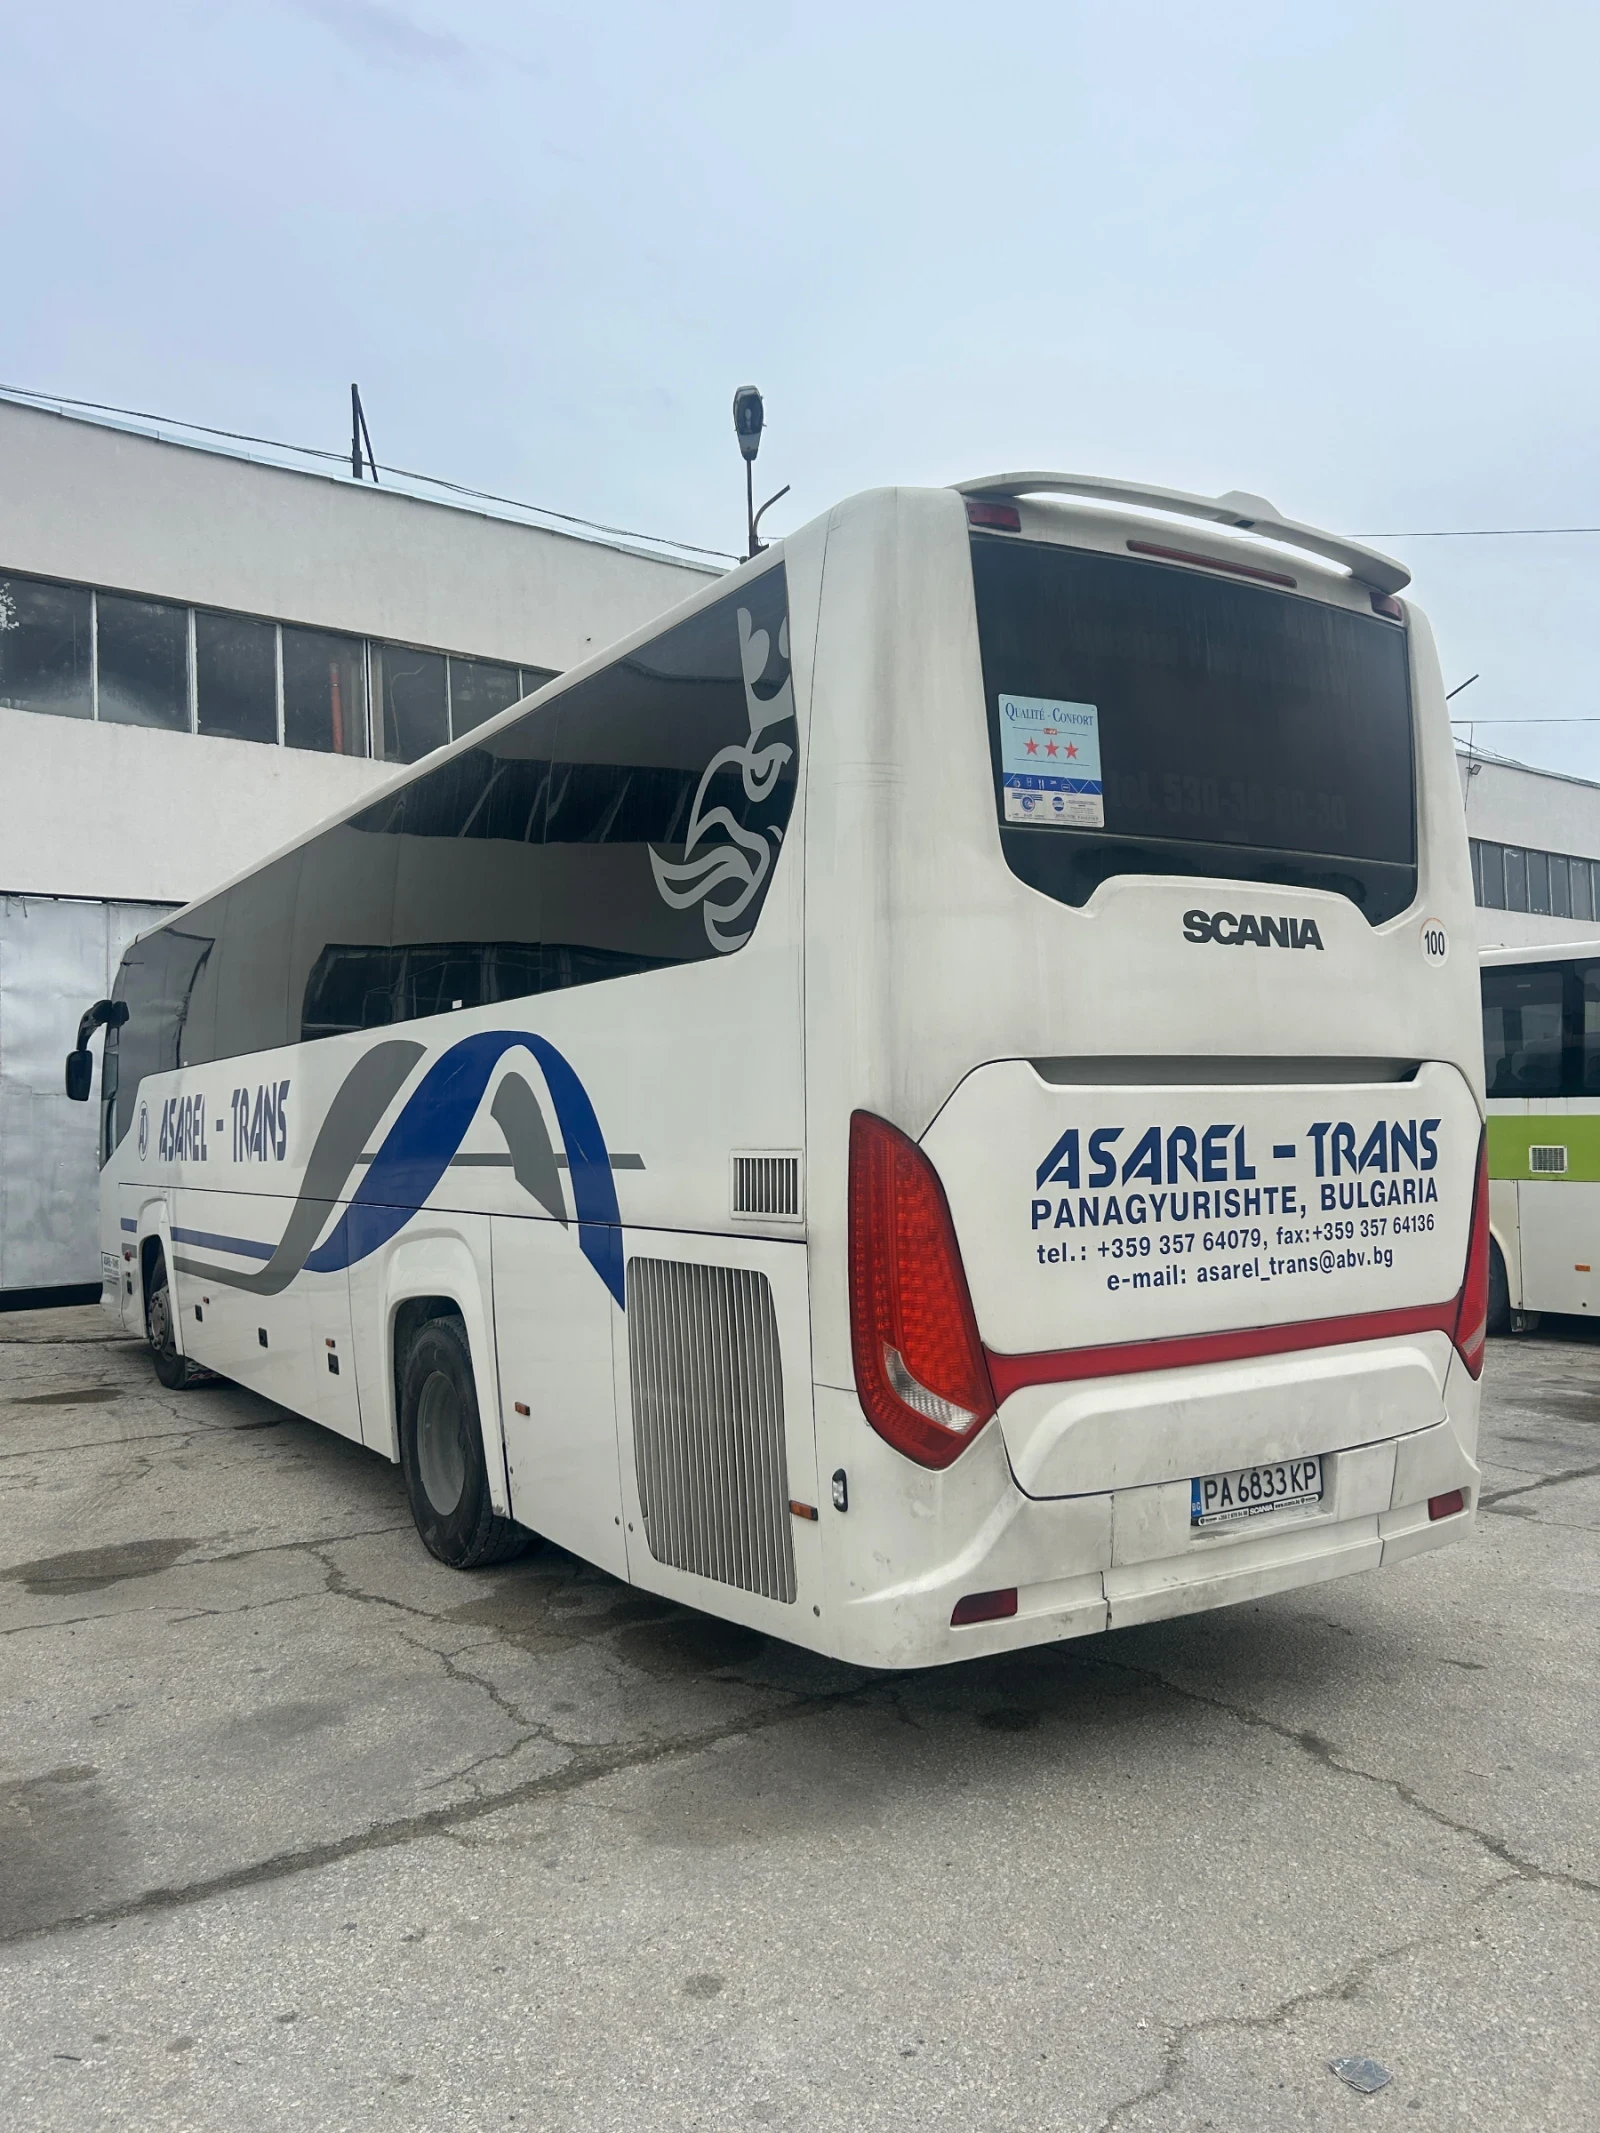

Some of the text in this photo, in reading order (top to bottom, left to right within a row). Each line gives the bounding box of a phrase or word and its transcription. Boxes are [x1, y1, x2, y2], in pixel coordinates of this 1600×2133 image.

[1005, 702, 1045, 721] QUALITÉ
[1052, 707, 1094, 726] CONFORT
[1182, 909, 1325, 950] SCANIA
[1424, 930, 1445, 956] 100
[158, 1093, 207, 1162] ASAREL
[230, 1079, 291, 1163] TRANS
[1036, 1124, 1257, 1192] ASAREL
[1305, 1118, 1442, 1178] TRANS
[1031, 1177, 1439, 1230] PANAGYURISHTE, BULGARIA
[1097, 1236, 1151, 1259] +359
[1158, 1232, 1196, 1255] 357
[1202, 1228, 1269, 1251] 64079,
[1360, 1217, 1388, 1239] 357
[1392, 1213, 1435, 1235] 64136
[1106, 1245, 1394, 1291] e-mail: asarel_trans@abv.bg
[1191, 1502, 1201, 1512] BG
[1249, 1504, 1274, 1516] SCANIA
